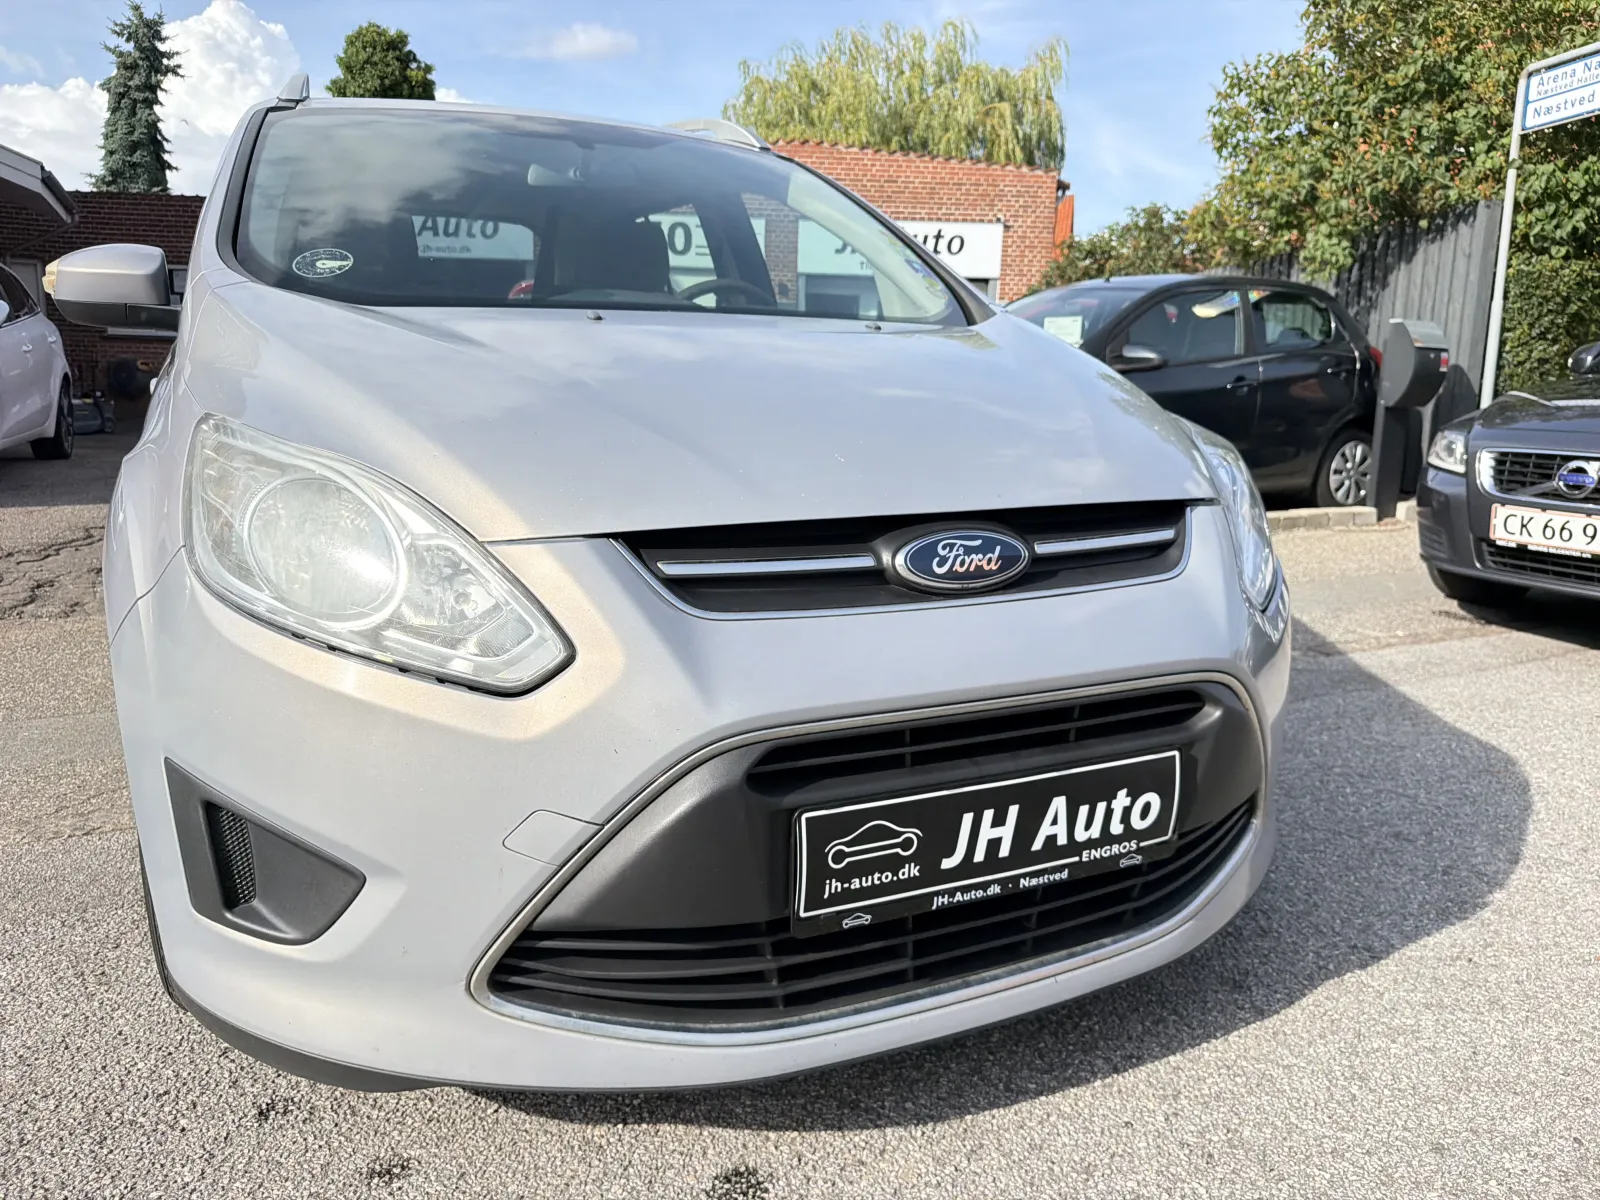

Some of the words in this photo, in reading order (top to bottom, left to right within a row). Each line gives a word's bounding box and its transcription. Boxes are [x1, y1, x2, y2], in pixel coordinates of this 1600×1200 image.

[1536, 68, 1577, 89] Arena
[1536, 79, 1574, 97] Næstved
[1532, 89, 1596, 119] Næstved
[416, 215, 500, 240] Auto
[1503, 513, 1535, 538] CK
[1542, 518, 1574, 543] 66
[1582, 523, 1598, 546] 9
[932, 539, 1002, 574] Ford
[940, 803, 1020, 870] JH
[1030, 787, 1161, 851] Auto
[1081, 840, 1138, 862] ENGROS
[823, 862, 921, 899] jh-auto.dk
[931, 884, 1002, 910] JH-Auto.dk
[1019, 868, 1069, 889] Næstved
